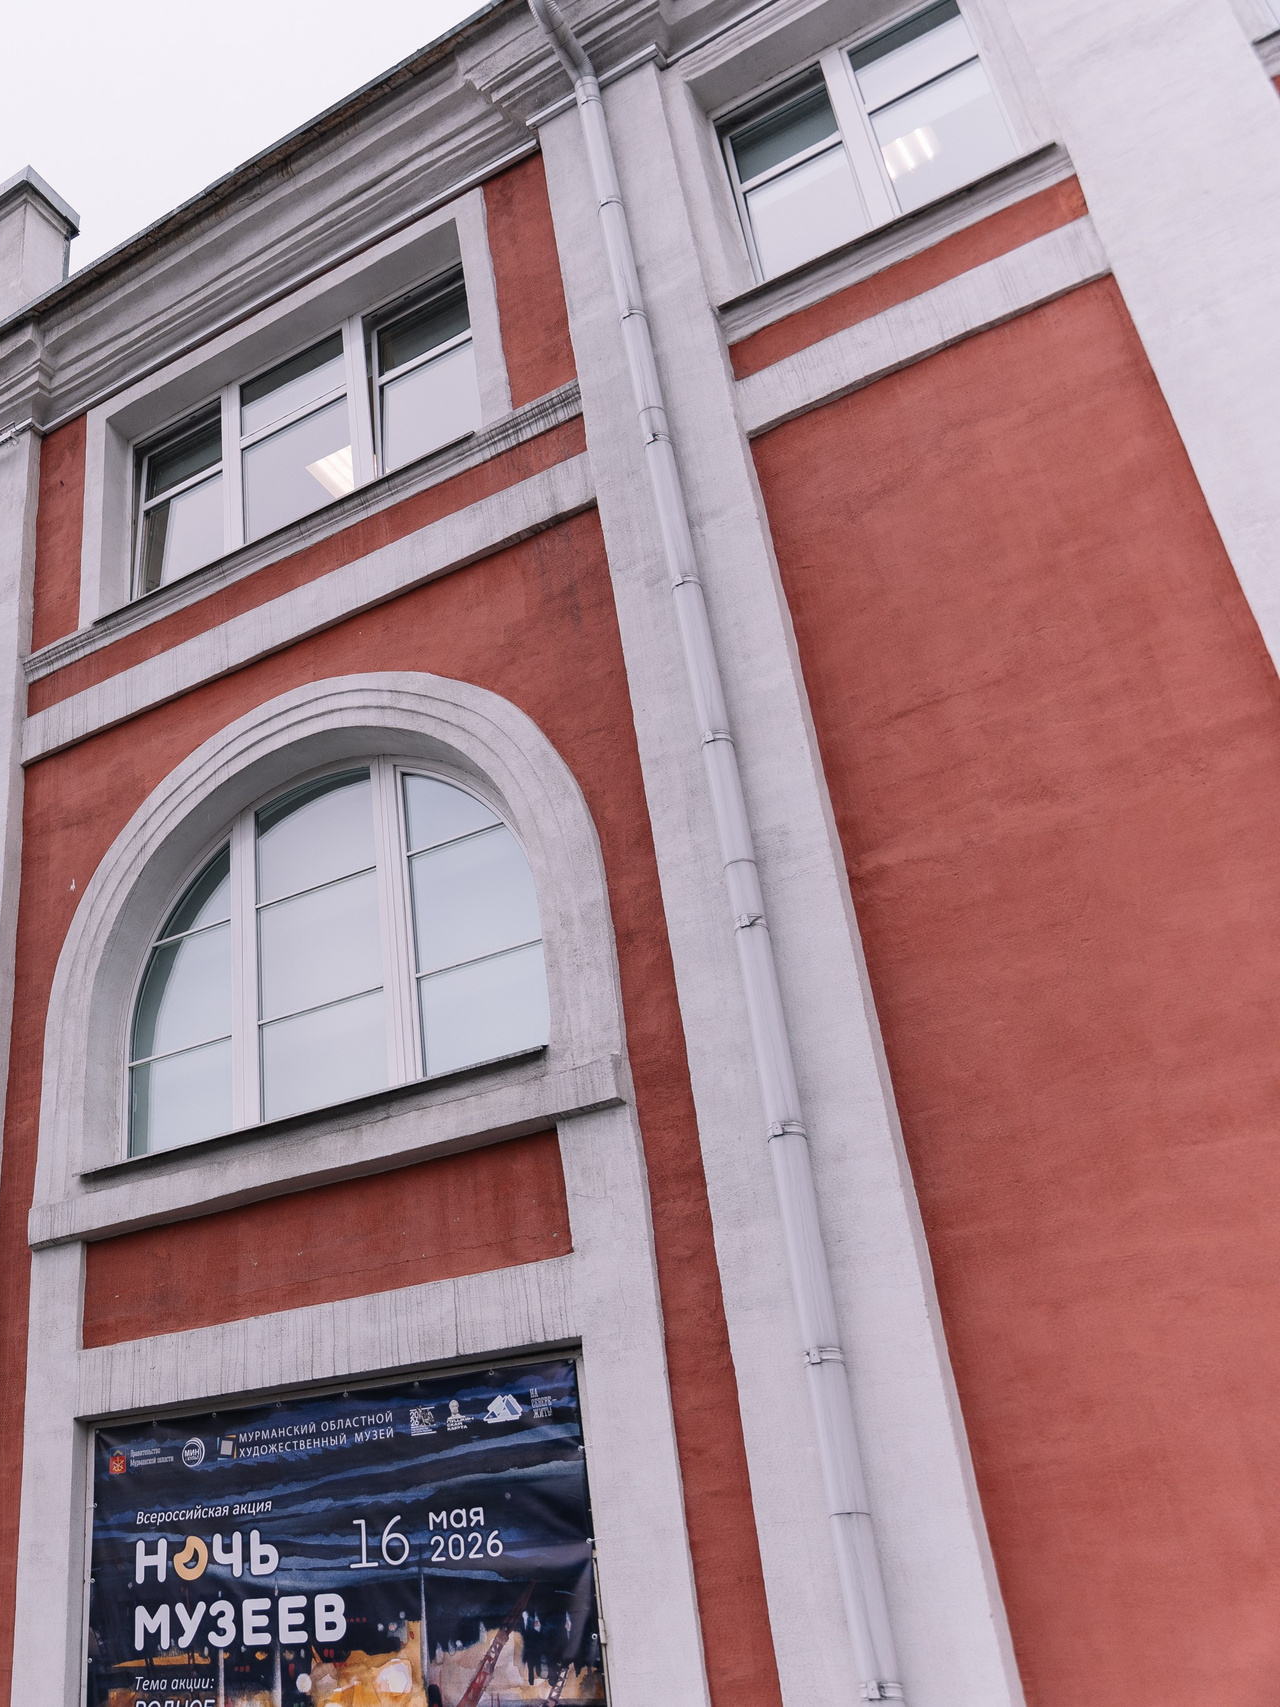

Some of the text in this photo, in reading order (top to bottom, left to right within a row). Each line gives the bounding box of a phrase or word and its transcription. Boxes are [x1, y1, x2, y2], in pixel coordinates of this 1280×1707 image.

[238, 1422, 316, 1443] МУРМАНСКИЙ
[320, 1411, 393, 1432] ОБЛАСТНОЙ
[239, 1433, 347, 1458] ХУДОЖЕСТВЕННЫЙ
[354, 1427, 394, 1443] МУЗЕЙ
[184, 1449, 200, 1457] МИН
[136, 1500, 272, 1526] Всероссийская акция
[428, 1507, 485, 1531] мая
[135, 1529, 279, 1584] НОЧЬ
[350, 1515, 410, 1568] 16
[430, 1530, 503, 1562] 2026
[135, 1593, 347, 1651] МУЗЕЕВ
[135, 1676, 215, 1695] Тема акции:
